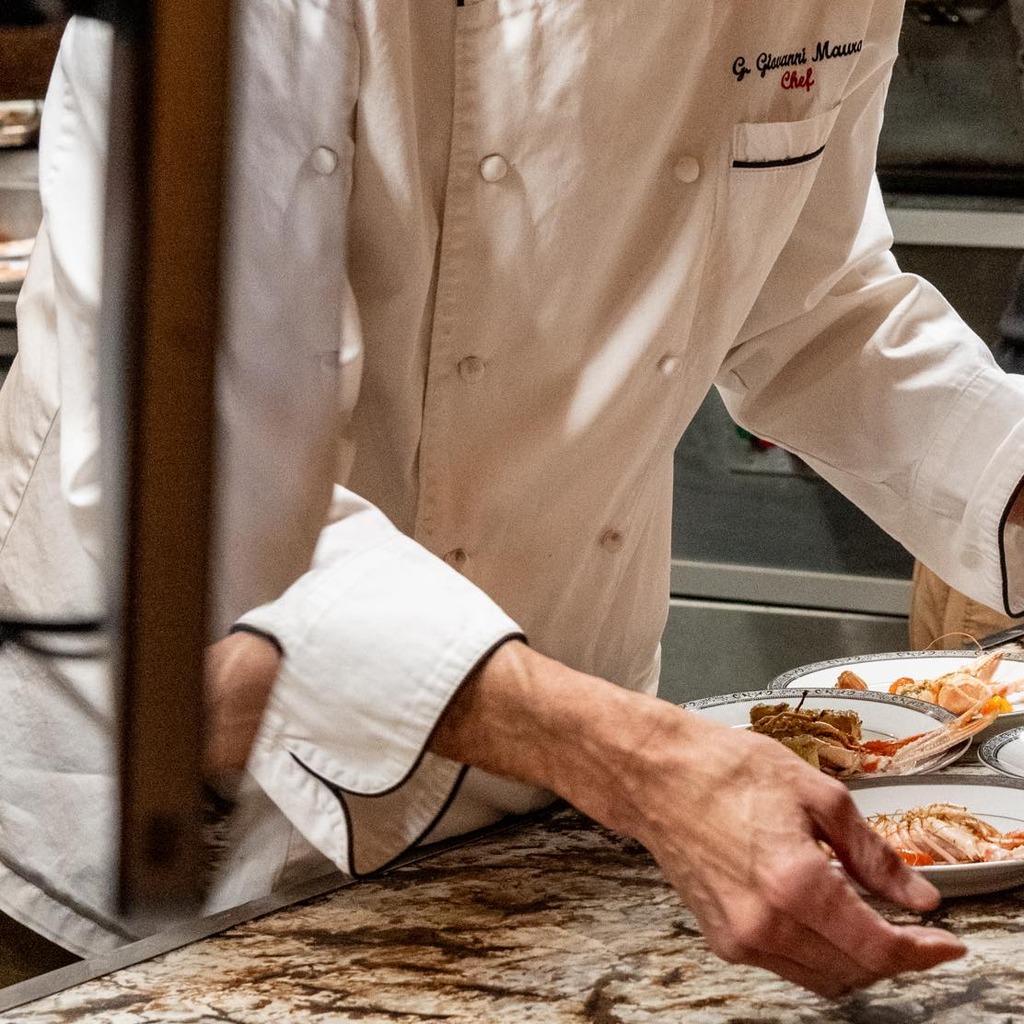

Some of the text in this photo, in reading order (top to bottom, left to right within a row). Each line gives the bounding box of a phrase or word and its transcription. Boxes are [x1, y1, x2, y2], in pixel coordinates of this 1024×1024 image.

[756, 47, 808, 78] Giovanni
[811, 39, 864, 63] Mauro
[780, 67, 815, 92] Chef
